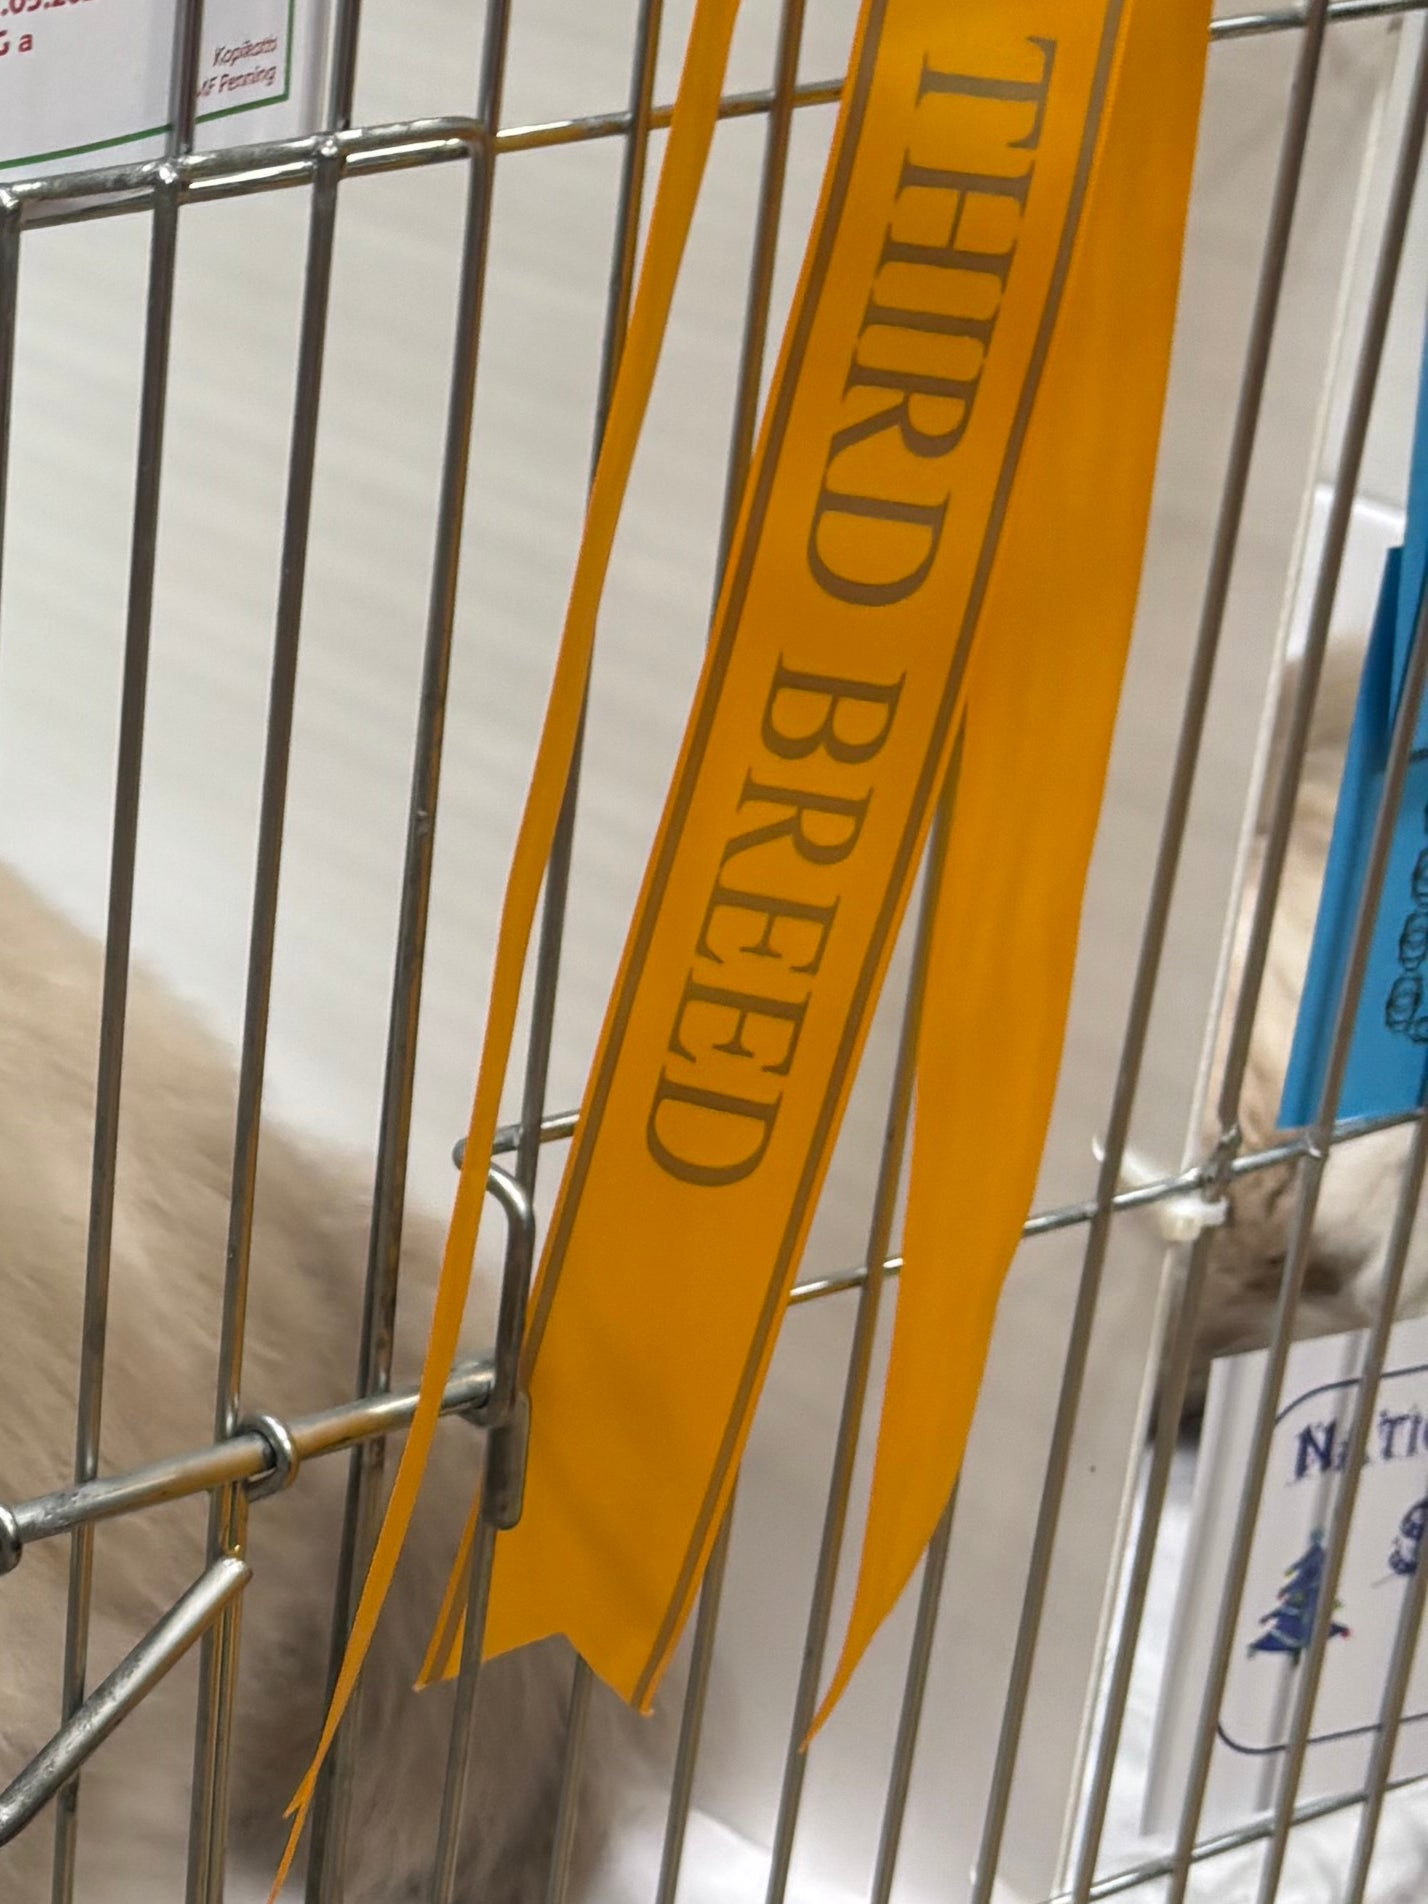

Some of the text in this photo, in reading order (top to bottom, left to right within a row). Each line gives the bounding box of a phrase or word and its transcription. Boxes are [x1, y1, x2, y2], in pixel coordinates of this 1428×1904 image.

[18, 31, 35, 54] a
[645, 33, 1058, 1188] THIRD BREED
